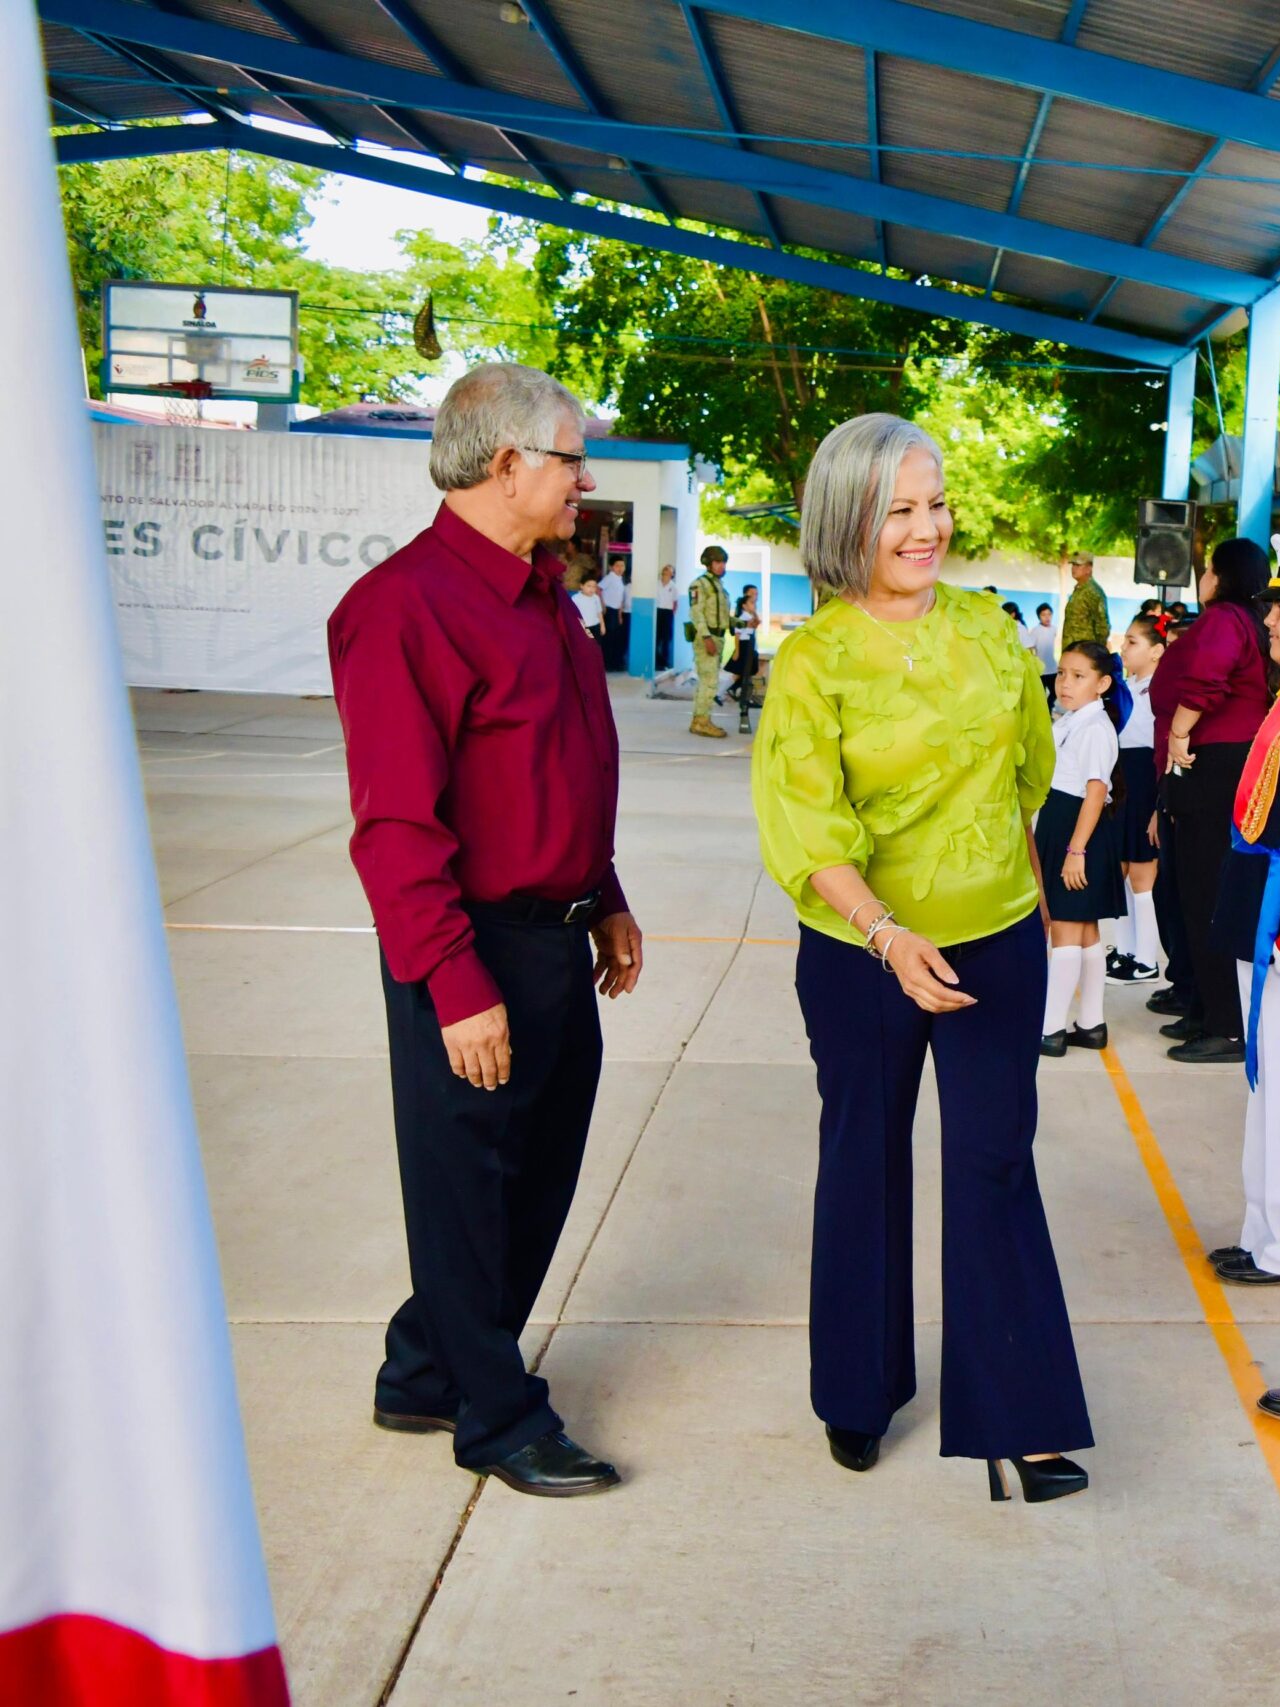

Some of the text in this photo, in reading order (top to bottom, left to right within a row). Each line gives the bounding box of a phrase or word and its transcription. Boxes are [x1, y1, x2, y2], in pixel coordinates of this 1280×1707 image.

[182, 320, 217, 328] SINALOA
[129, 496, 144, 505] DE
[149, 497, 215, 508] SALVADOR
[219, 502, 286, 512] ALVARADO
